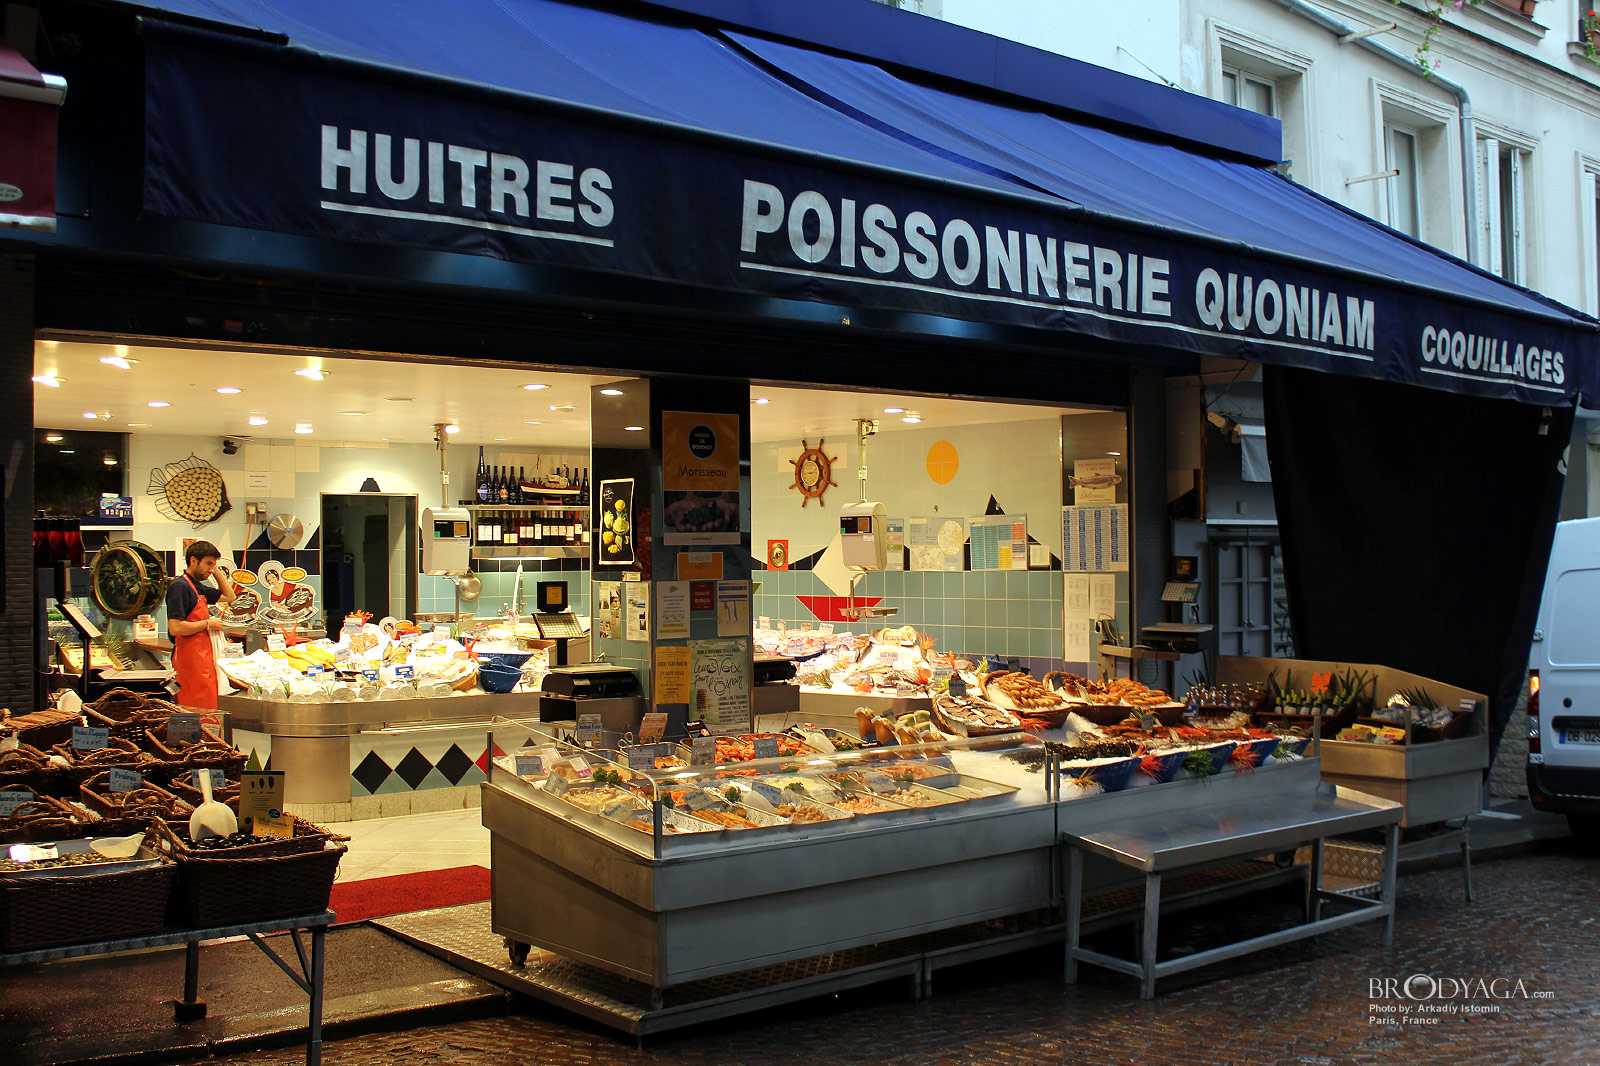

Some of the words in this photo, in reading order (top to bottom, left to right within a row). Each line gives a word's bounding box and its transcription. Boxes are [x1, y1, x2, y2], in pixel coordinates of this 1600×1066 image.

[320, 124, 615, 228] HUITRES
[740, 178, 1172, 318] POISSONNERIE
[1195, 267, 1375, 351] QUONIAM
[1420, 324, 1566, 385] COQUILLAGES
[678, 465, 727, 477] Morisseau
